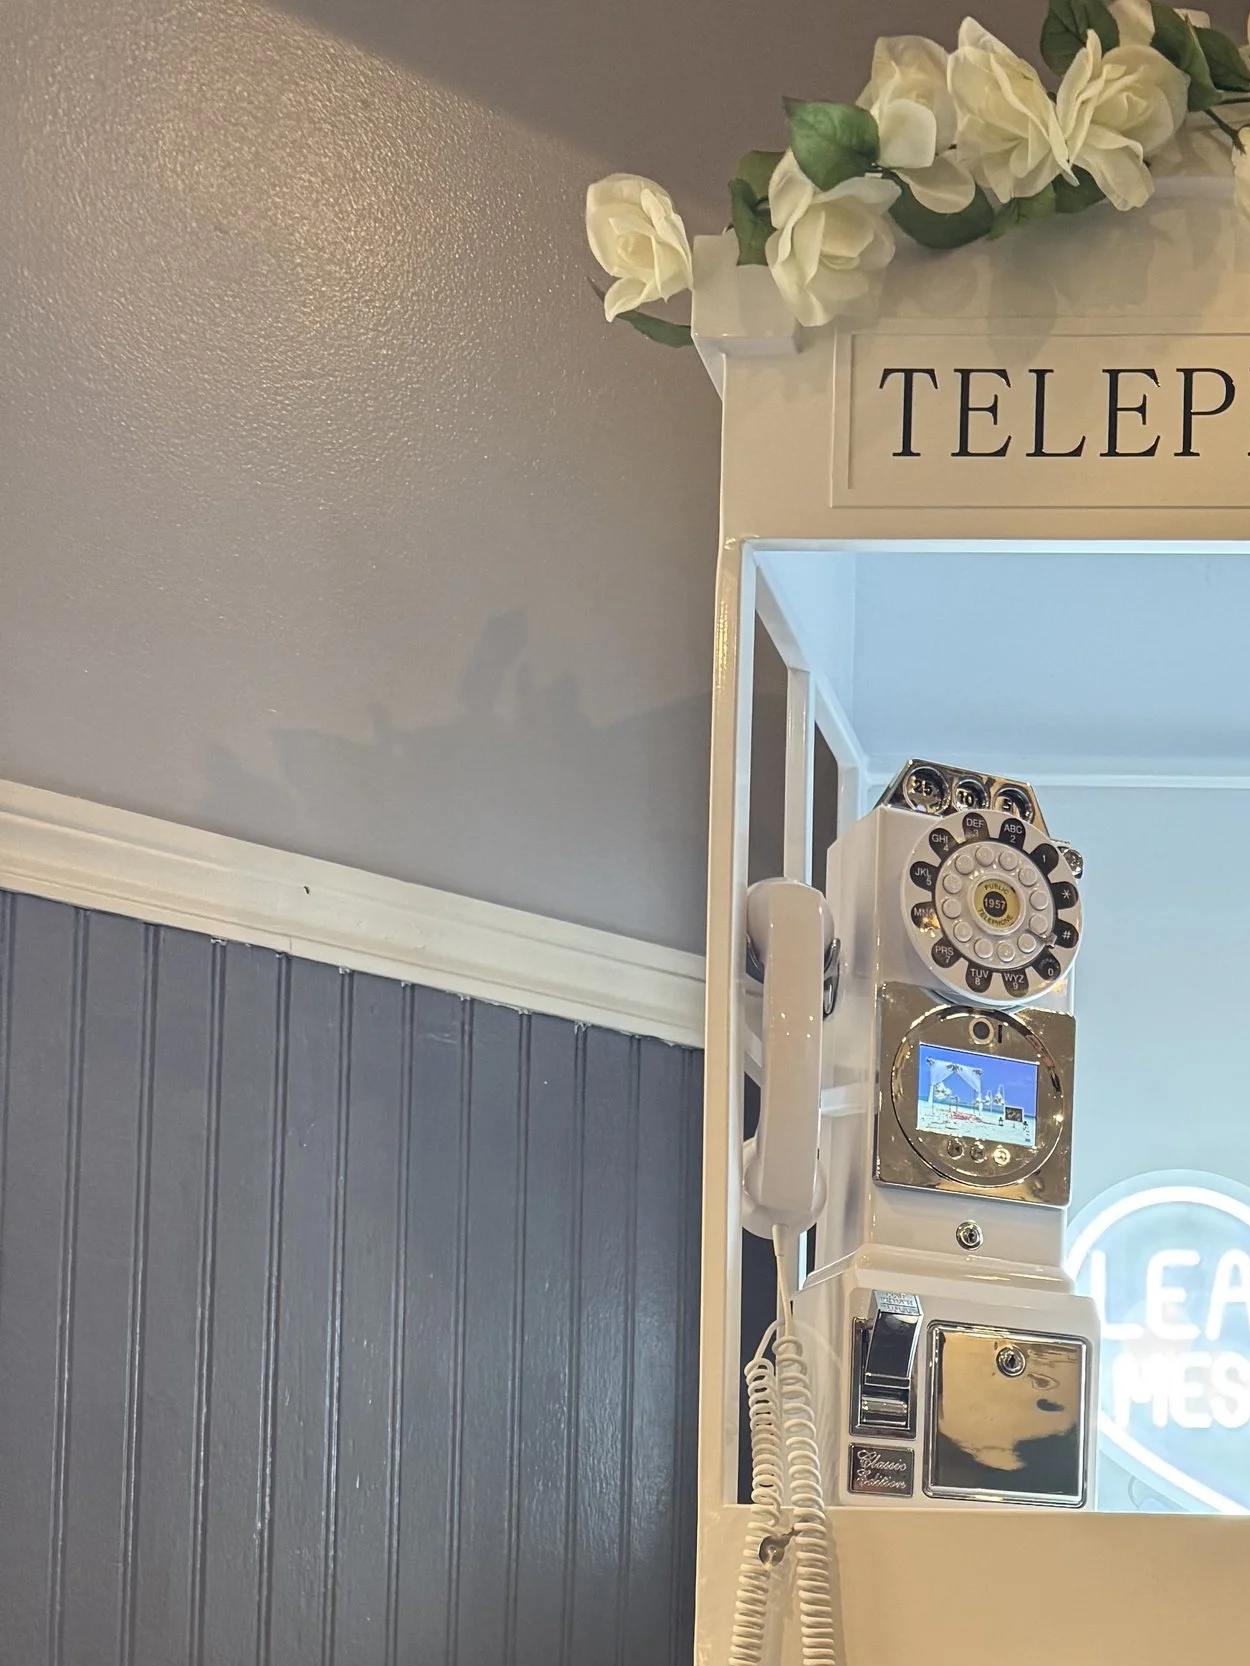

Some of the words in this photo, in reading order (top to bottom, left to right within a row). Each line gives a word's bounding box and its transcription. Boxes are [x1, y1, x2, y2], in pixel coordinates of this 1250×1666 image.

[966, 818, 984, 829] DEF
[1003, 824, 1023, 834] ABC
[932, 833, 949, 844] GHI
[1010, 834, 1016, 843] 2
[943, 843, 949, 851] 4
[1042, 854, 1047, 863] 1
[915, 867, 932, 878] JKL
[926, 877, 932, 886] 5
[984, 897, 1006, 910] 1957
[935, 946, 954, 957] PRS
[946, 954, 951, 963] 7
[970, 968, 989, 979] TUV
[1004, 972, 1024, 984] WYZ
[974, 977, 980, 986] 8
[1013, 982, 1019, 990] 9
[857, 1449, 907, 1471] Classic
[857, 1468, 907, 1489] Edition
